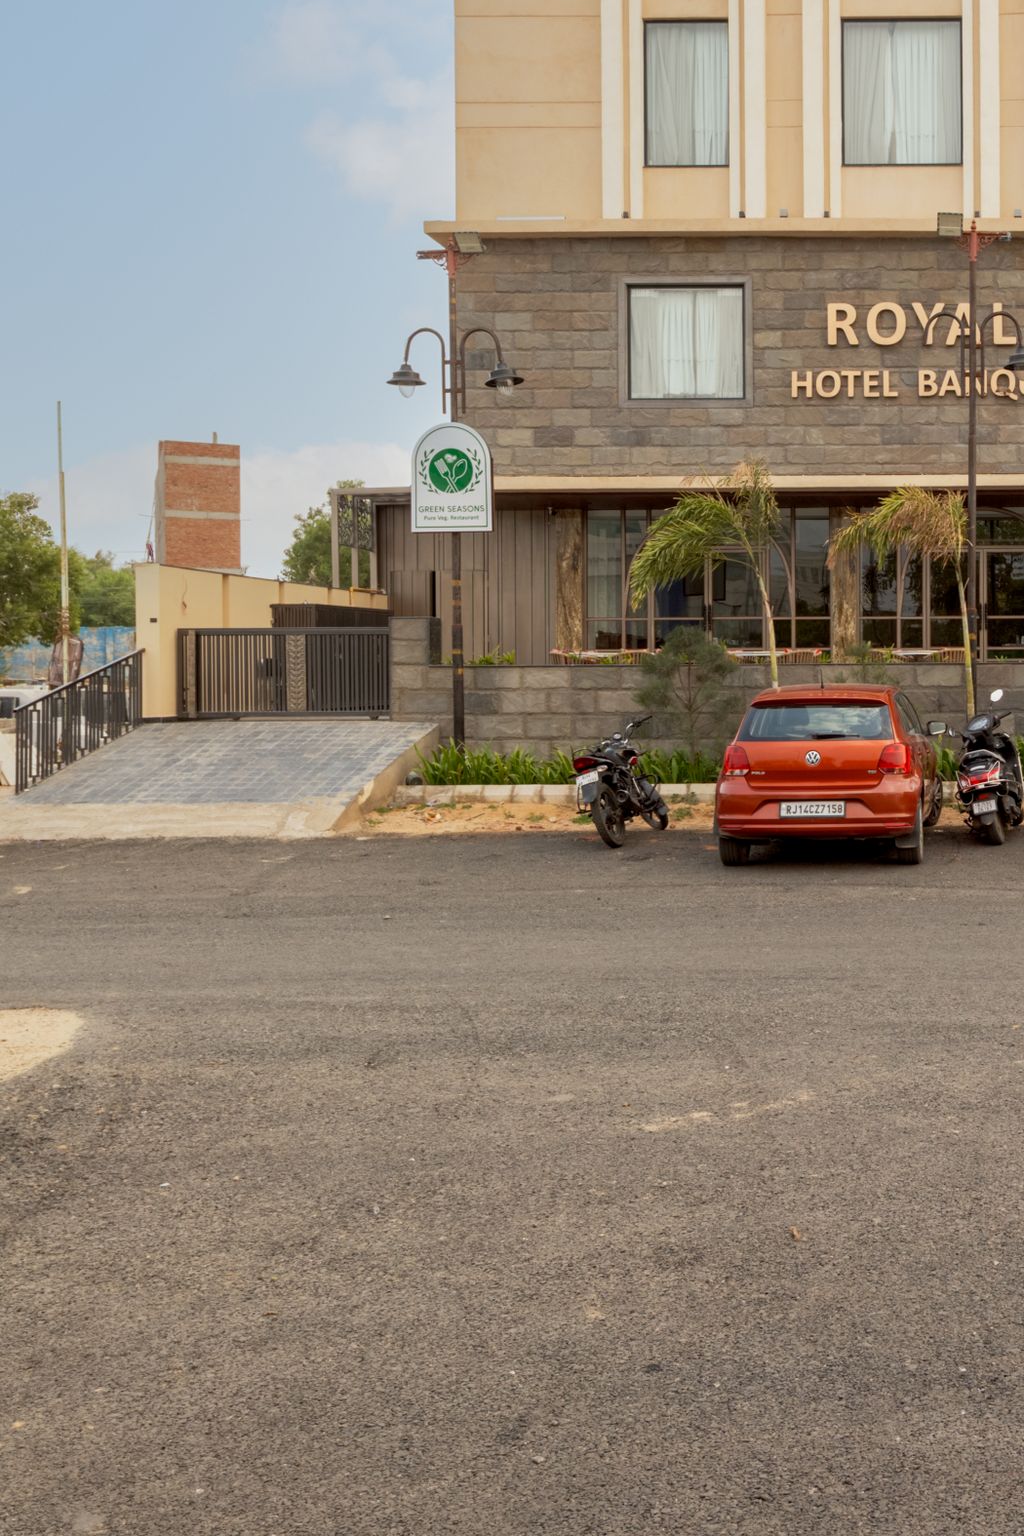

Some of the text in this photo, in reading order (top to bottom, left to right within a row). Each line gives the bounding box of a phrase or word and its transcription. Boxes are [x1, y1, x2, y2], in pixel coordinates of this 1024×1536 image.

[826, 301, 1017, 346] ROYAL
[791, 369, 898, 398] HOTEL
[418, 505, 445, 513] GREEN
[786, 804, 843, 815] RJ14CZ7158
